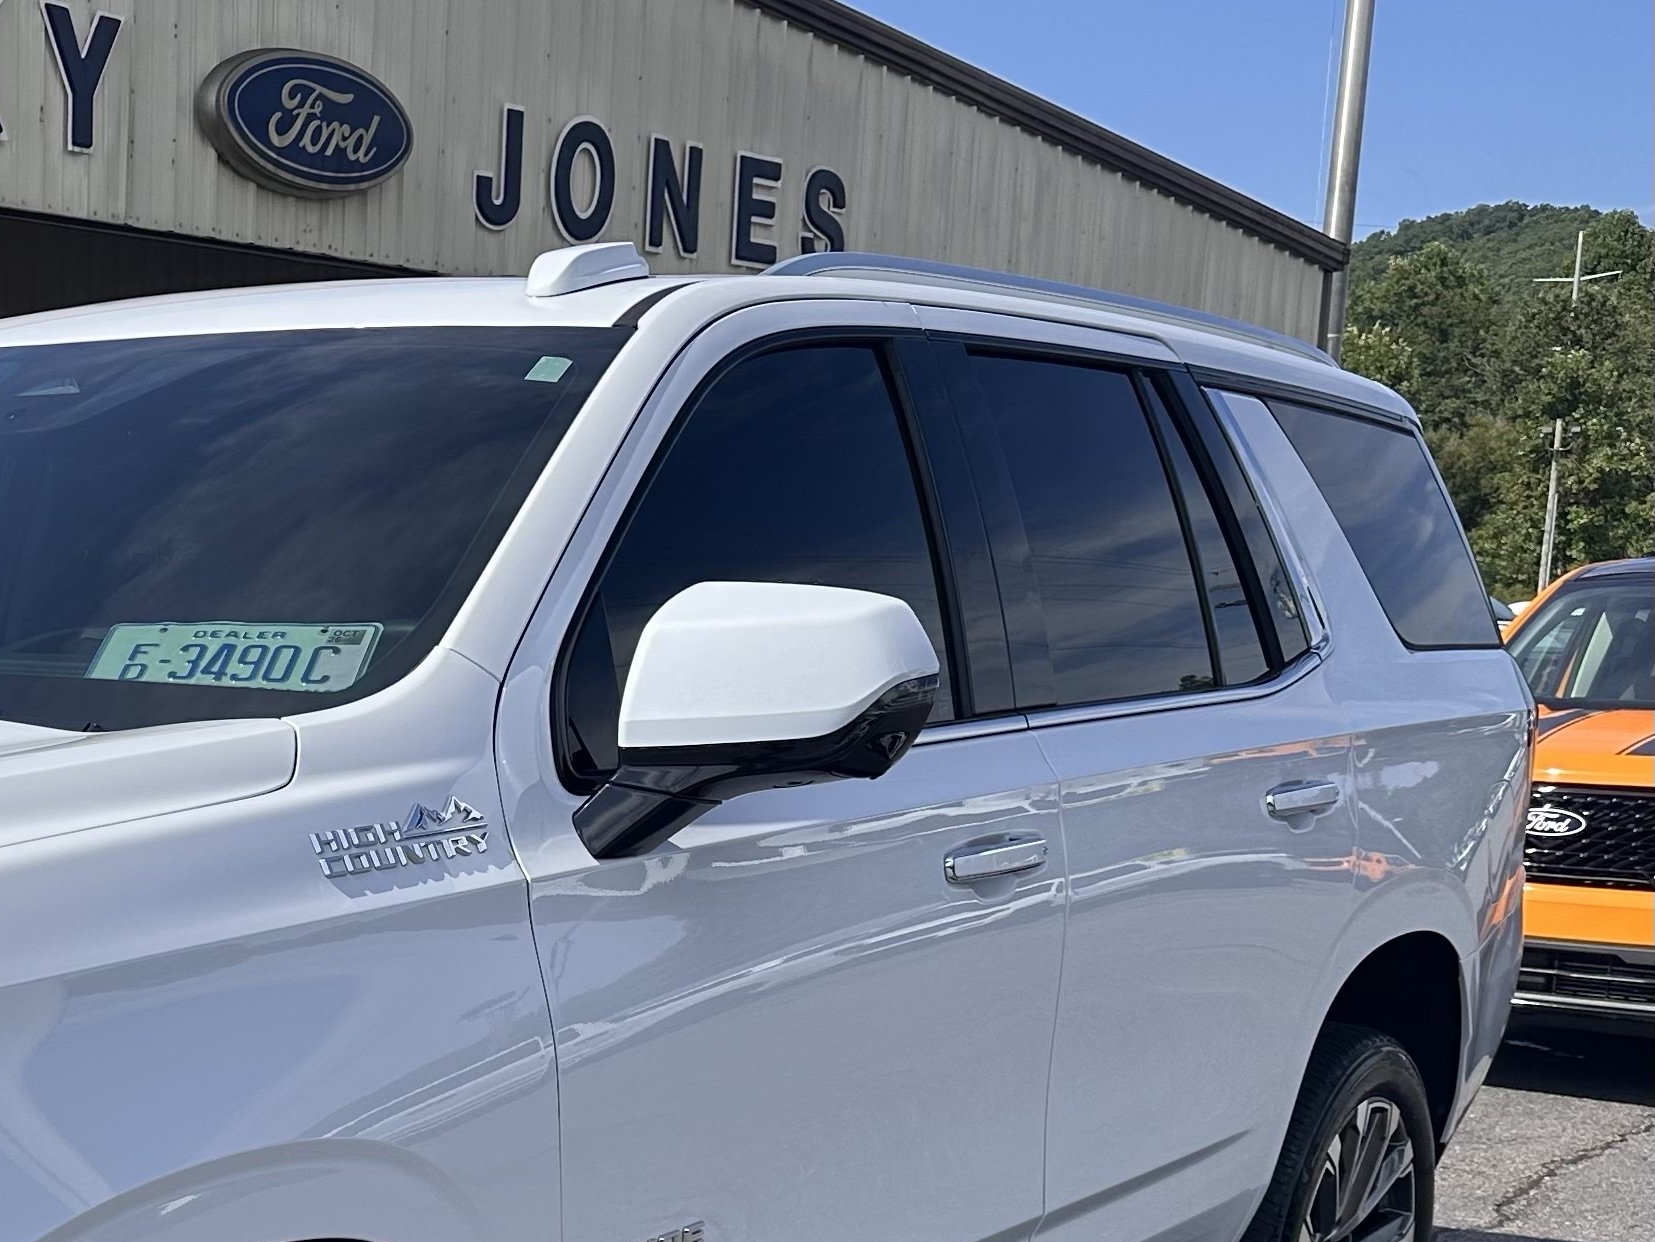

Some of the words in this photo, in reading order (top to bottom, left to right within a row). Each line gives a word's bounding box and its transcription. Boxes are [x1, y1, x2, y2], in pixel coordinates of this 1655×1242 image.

[268, 78, 380, 164] Ford
[473, 103, 846, 268] JONES
[193, 629, 287, 640] DEALER
[309, 821, 403, 854] HIGH
[1525, 811, 1571, 833] Ford
[318, 831, 489, 879] COUNTRY
